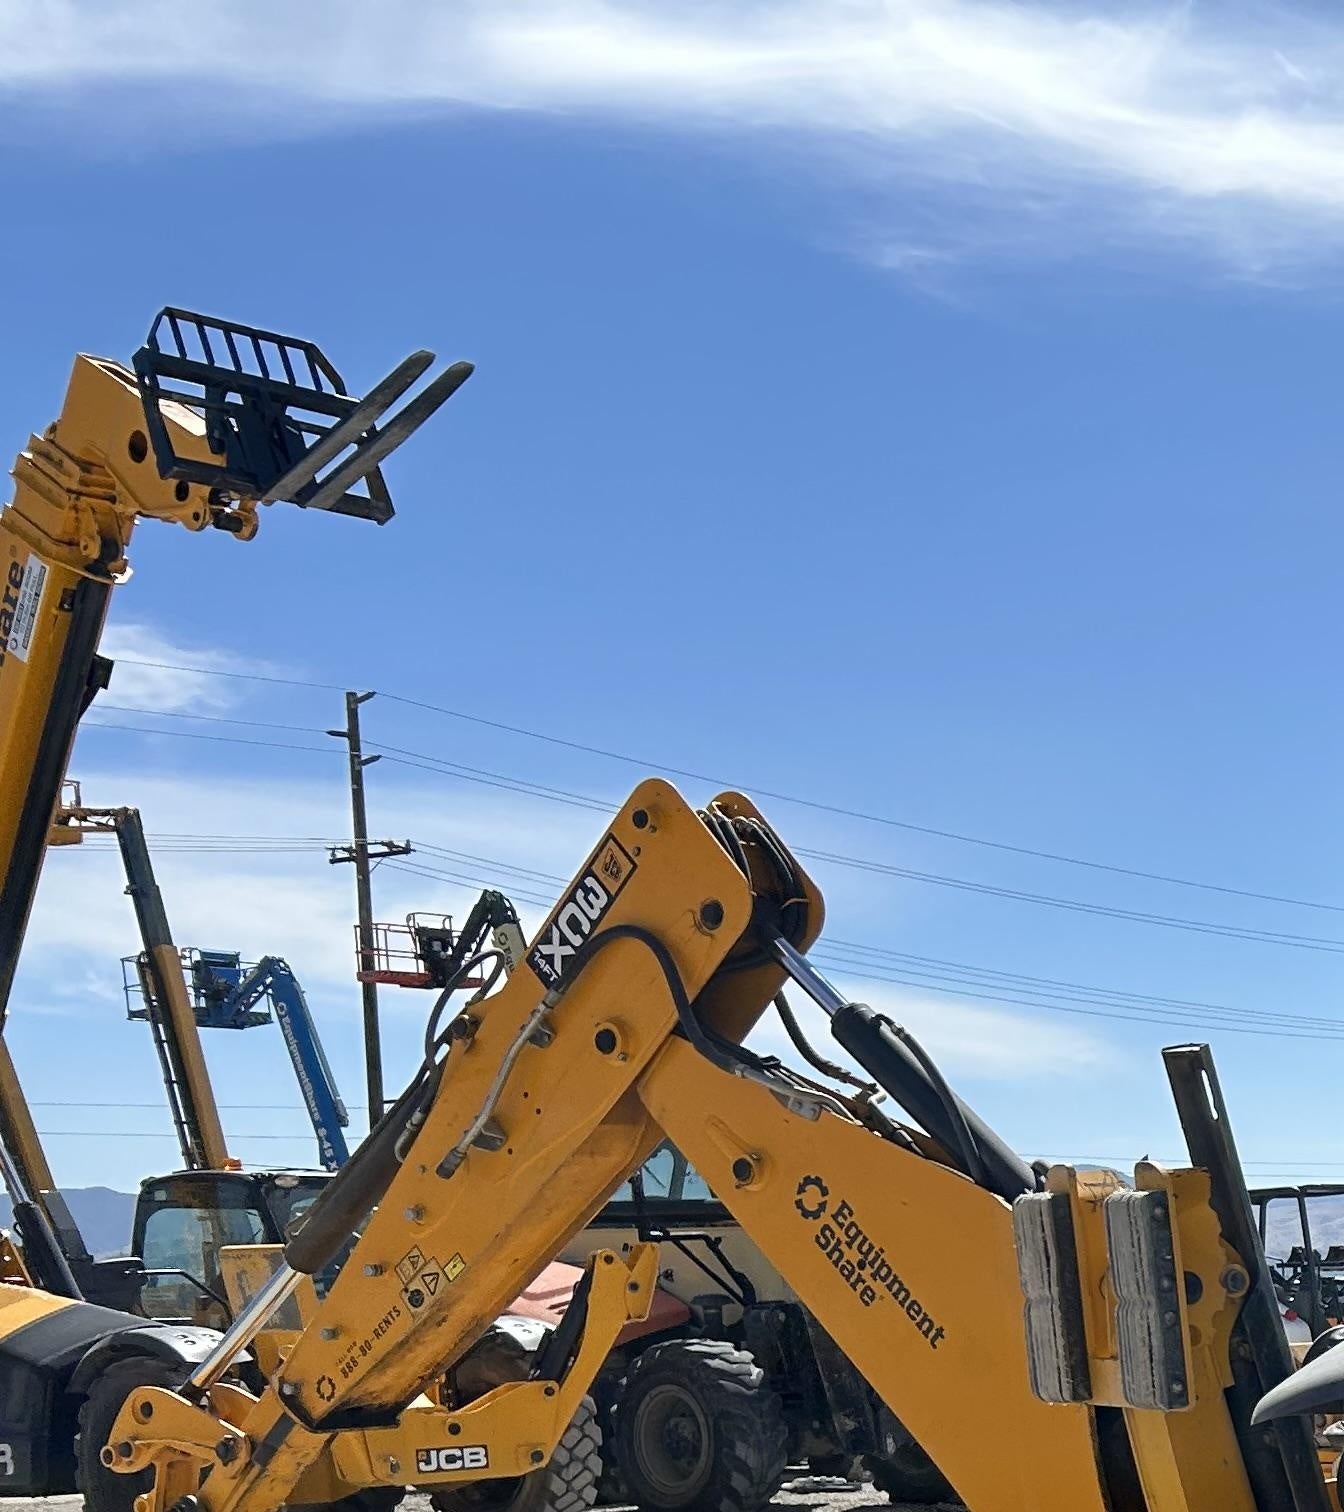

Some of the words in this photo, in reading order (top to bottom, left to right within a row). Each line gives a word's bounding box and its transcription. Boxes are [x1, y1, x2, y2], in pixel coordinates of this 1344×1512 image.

[538, 876, 608, 977] 3CX
[532, 951, 560, 982] 14FT
[814, 1223, 876, 1307] Share
[831, 1200, 945, 1349] Equipment
[340, 1305, 401, 1379] 888-80-RENTS
[418, 1447, 488, 1472] JCB
